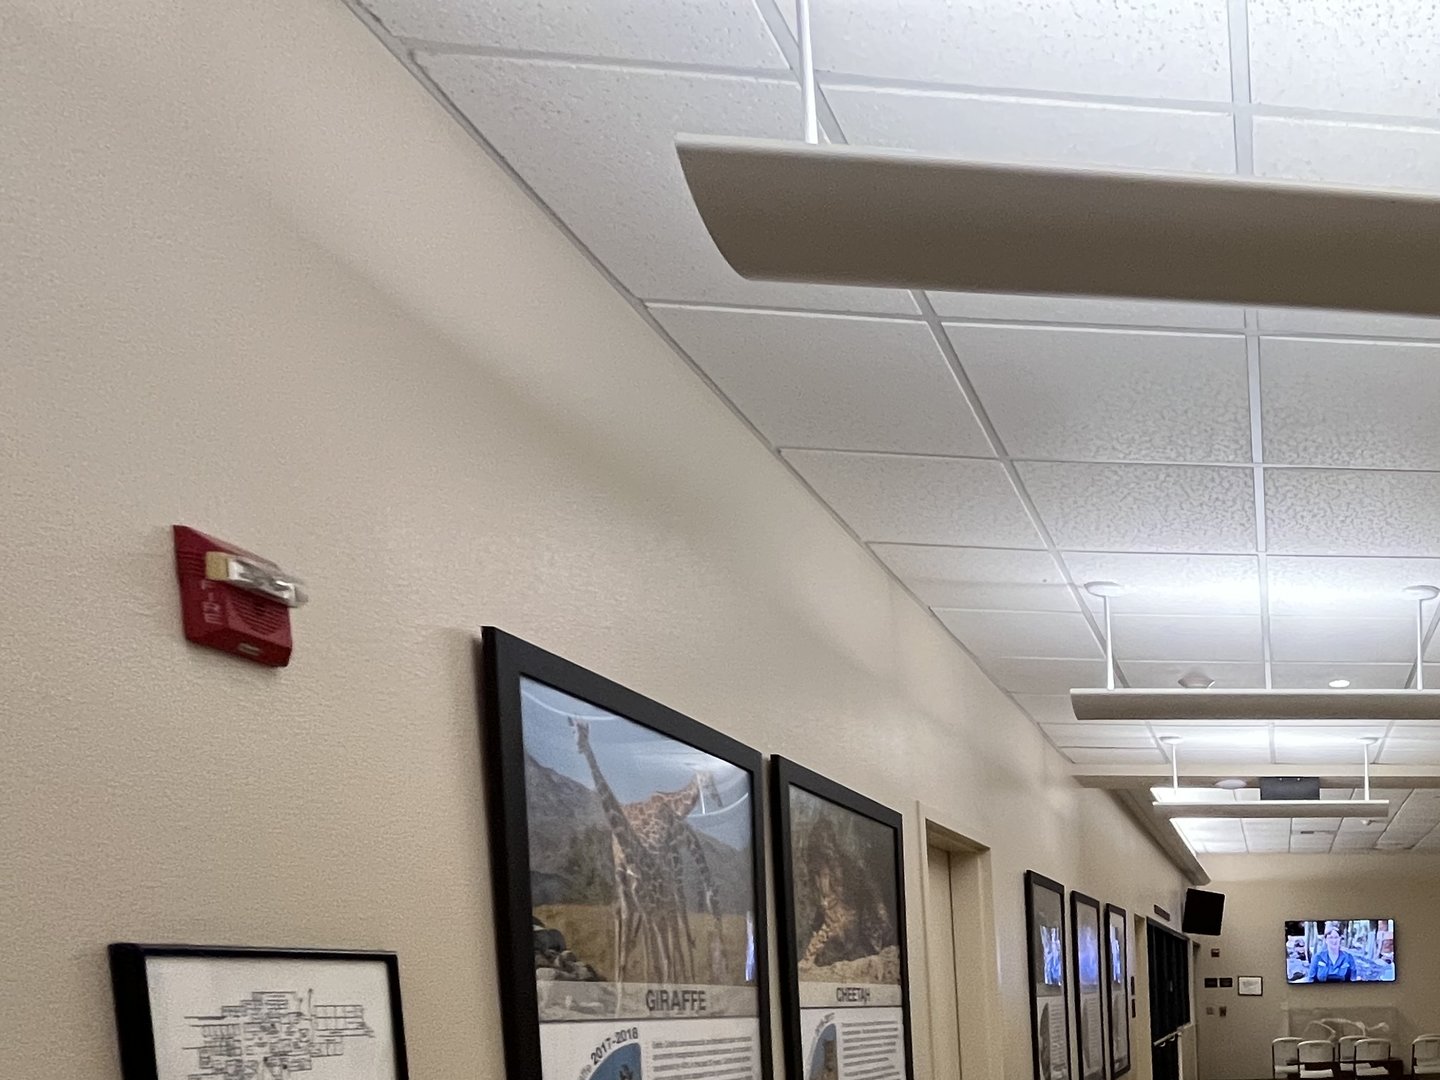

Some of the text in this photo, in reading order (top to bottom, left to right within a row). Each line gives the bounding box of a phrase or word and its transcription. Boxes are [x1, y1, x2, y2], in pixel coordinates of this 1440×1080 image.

[645, 989, 707, 1012] GIRAFFE
[836, 987, 871, 1004] CHEETAH
[590, 1026, 639, 1066] 2017-2018
